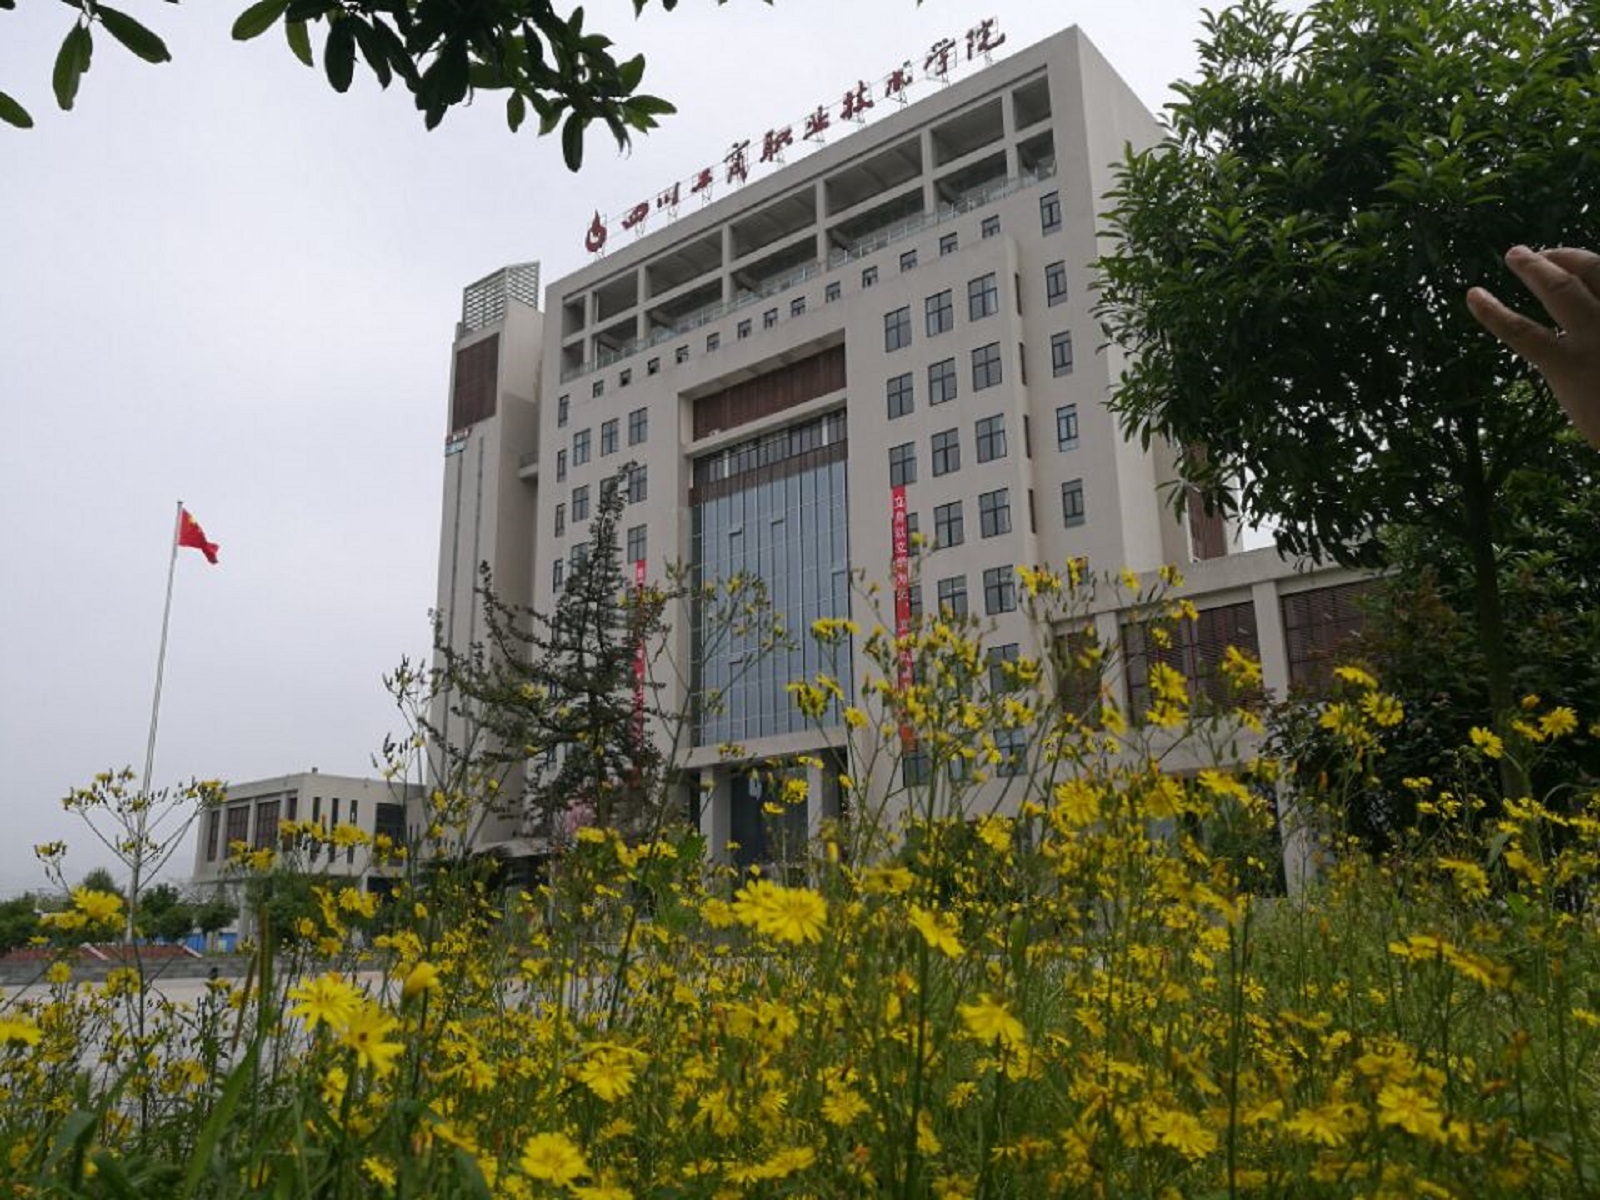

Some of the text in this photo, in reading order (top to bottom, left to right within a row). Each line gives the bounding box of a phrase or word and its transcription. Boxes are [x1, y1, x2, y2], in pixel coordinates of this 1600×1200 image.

[621, 18, 1006, 231] 四川工商职业技术学院
